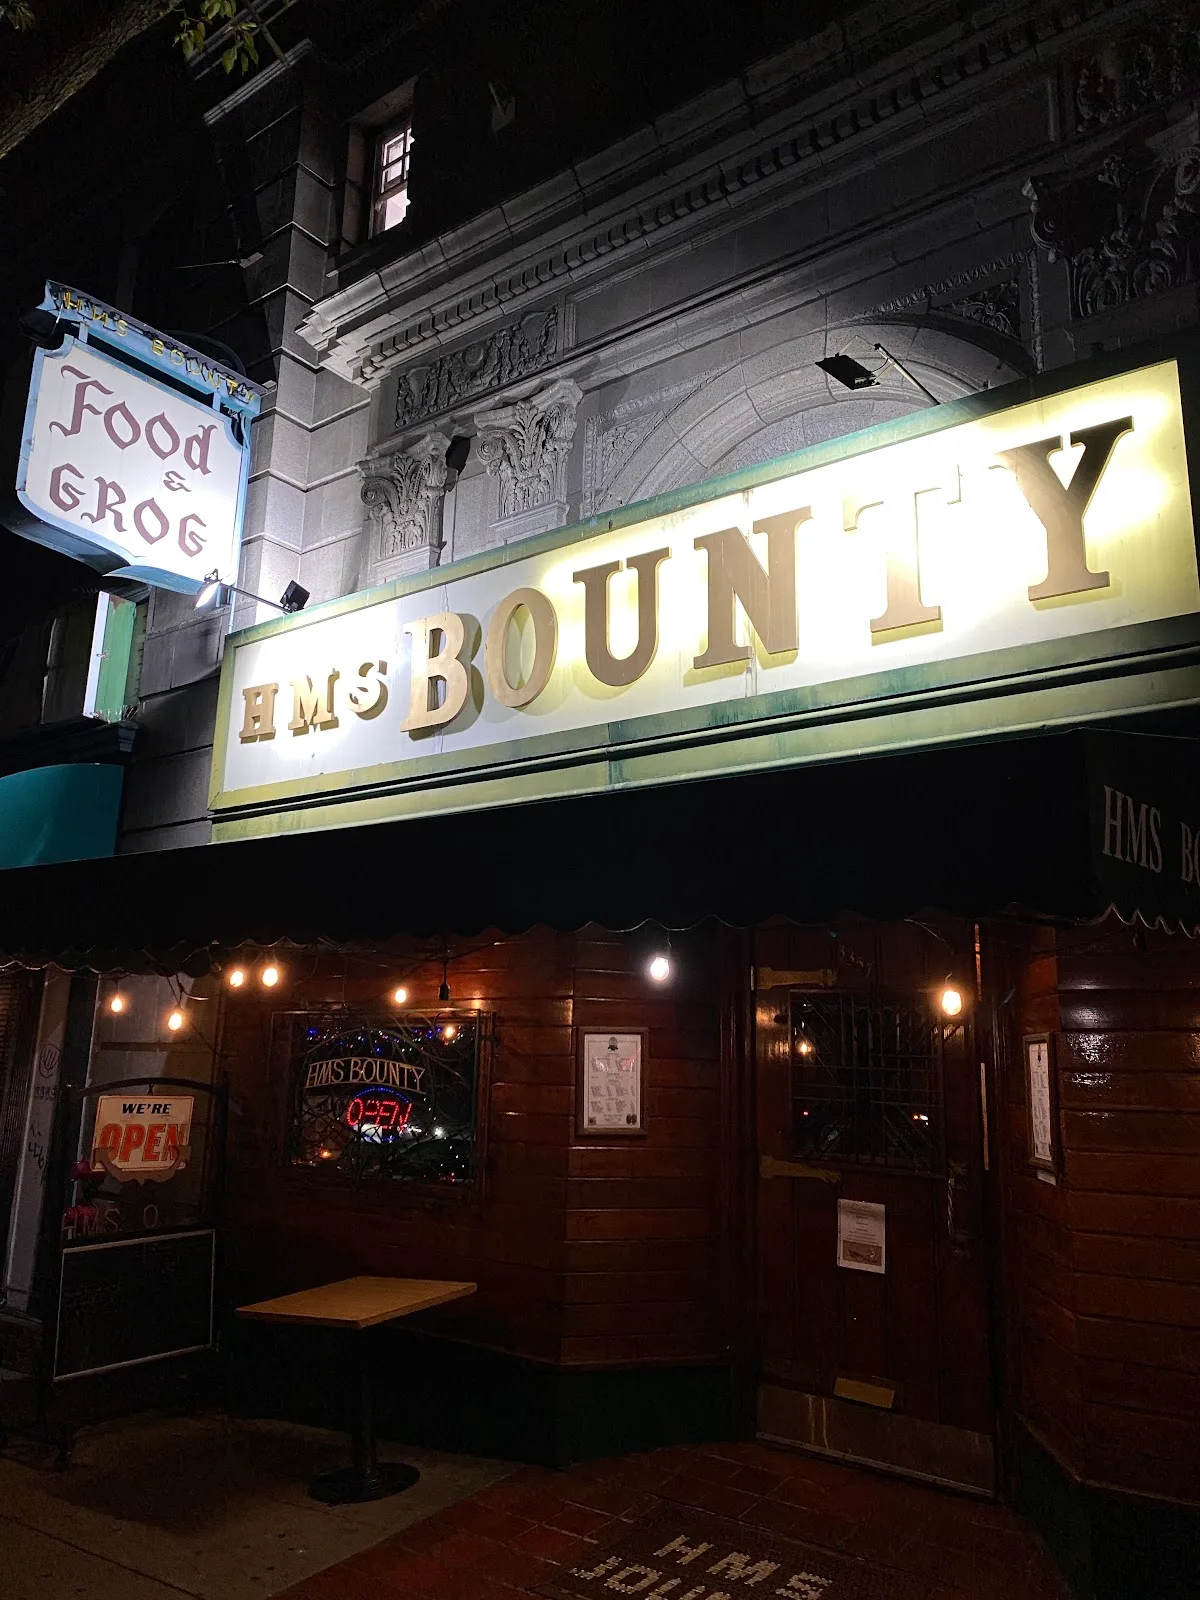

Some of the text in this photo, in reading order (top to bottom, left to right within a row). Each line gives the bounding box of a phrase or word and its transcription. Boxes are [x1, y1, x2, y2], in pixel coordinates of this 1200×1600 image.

[63, 290, 256, 404] HMS BOUNTY
[162, 470, 192, 493] &
[49, 463, 208, 558] GROG
[239, 416, 1135, 743] HMS BOUNTY
[1102, 784, 1164, 874] HMS
[304, 1056, 427, 1095] HMS BOUNTY
[122, 1103, 172, 1115] WE'RE
[345, 1097, 413, 1134] OPEN
[100, 1122, 189, 1162] OPEN
[653, 1534, 833, 1600] HMS
